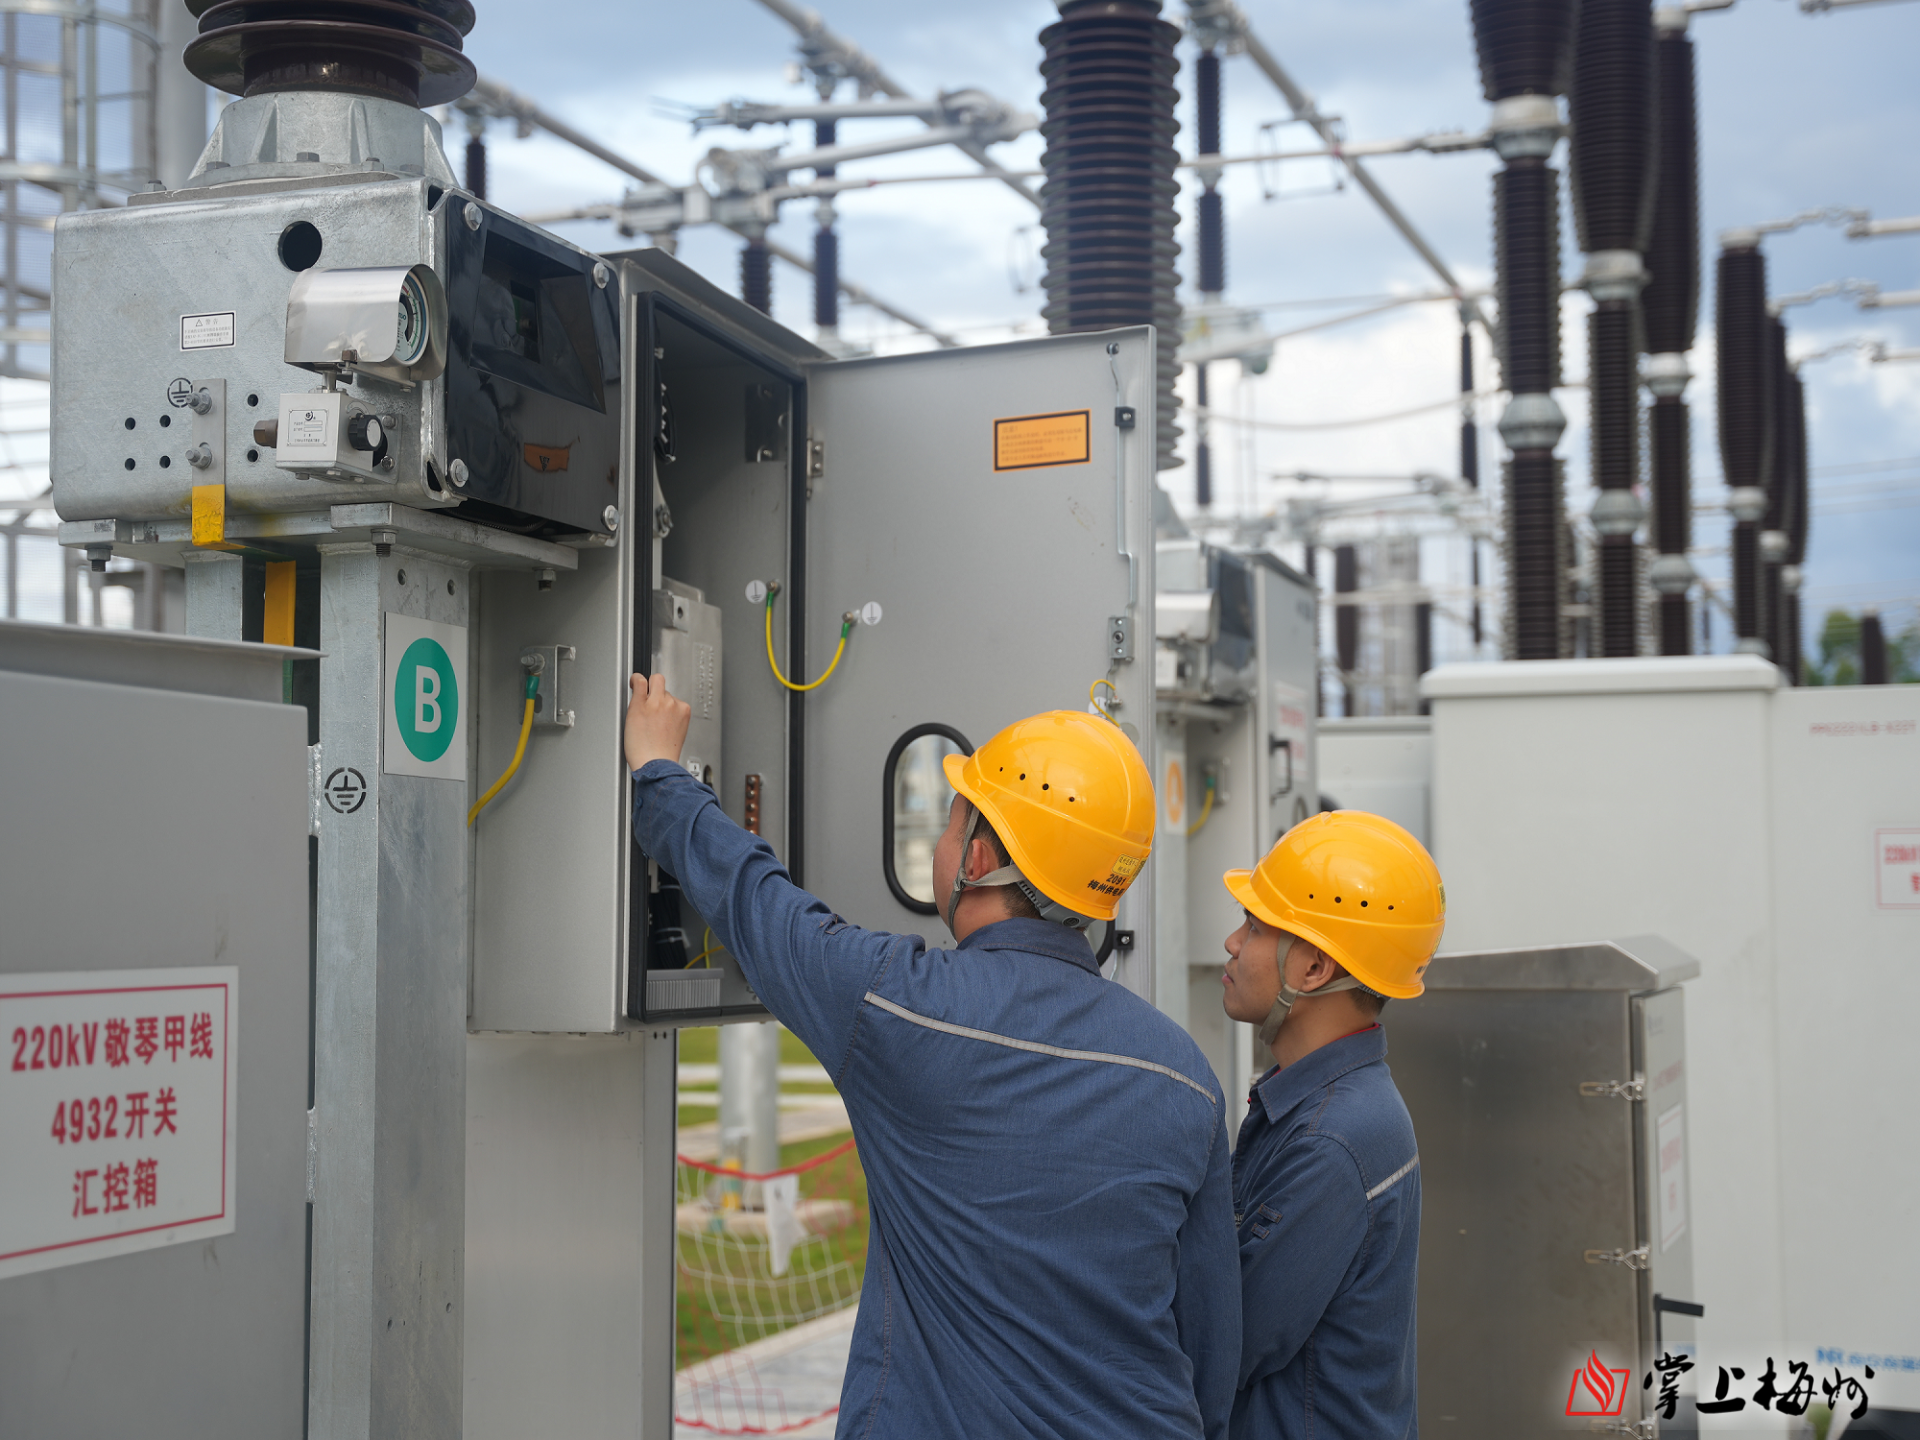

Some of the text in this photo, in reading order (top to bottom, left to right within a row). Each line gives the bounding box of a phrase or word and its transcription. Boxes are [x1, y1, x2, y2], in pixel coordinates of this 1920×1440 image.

[414, 664, 442, 734] B
[1105, 873, 1127, 887] 2091
[51, 1086, 178, 1145] 4932开关
[71, 1157, 159, 1219] 汇控箱
